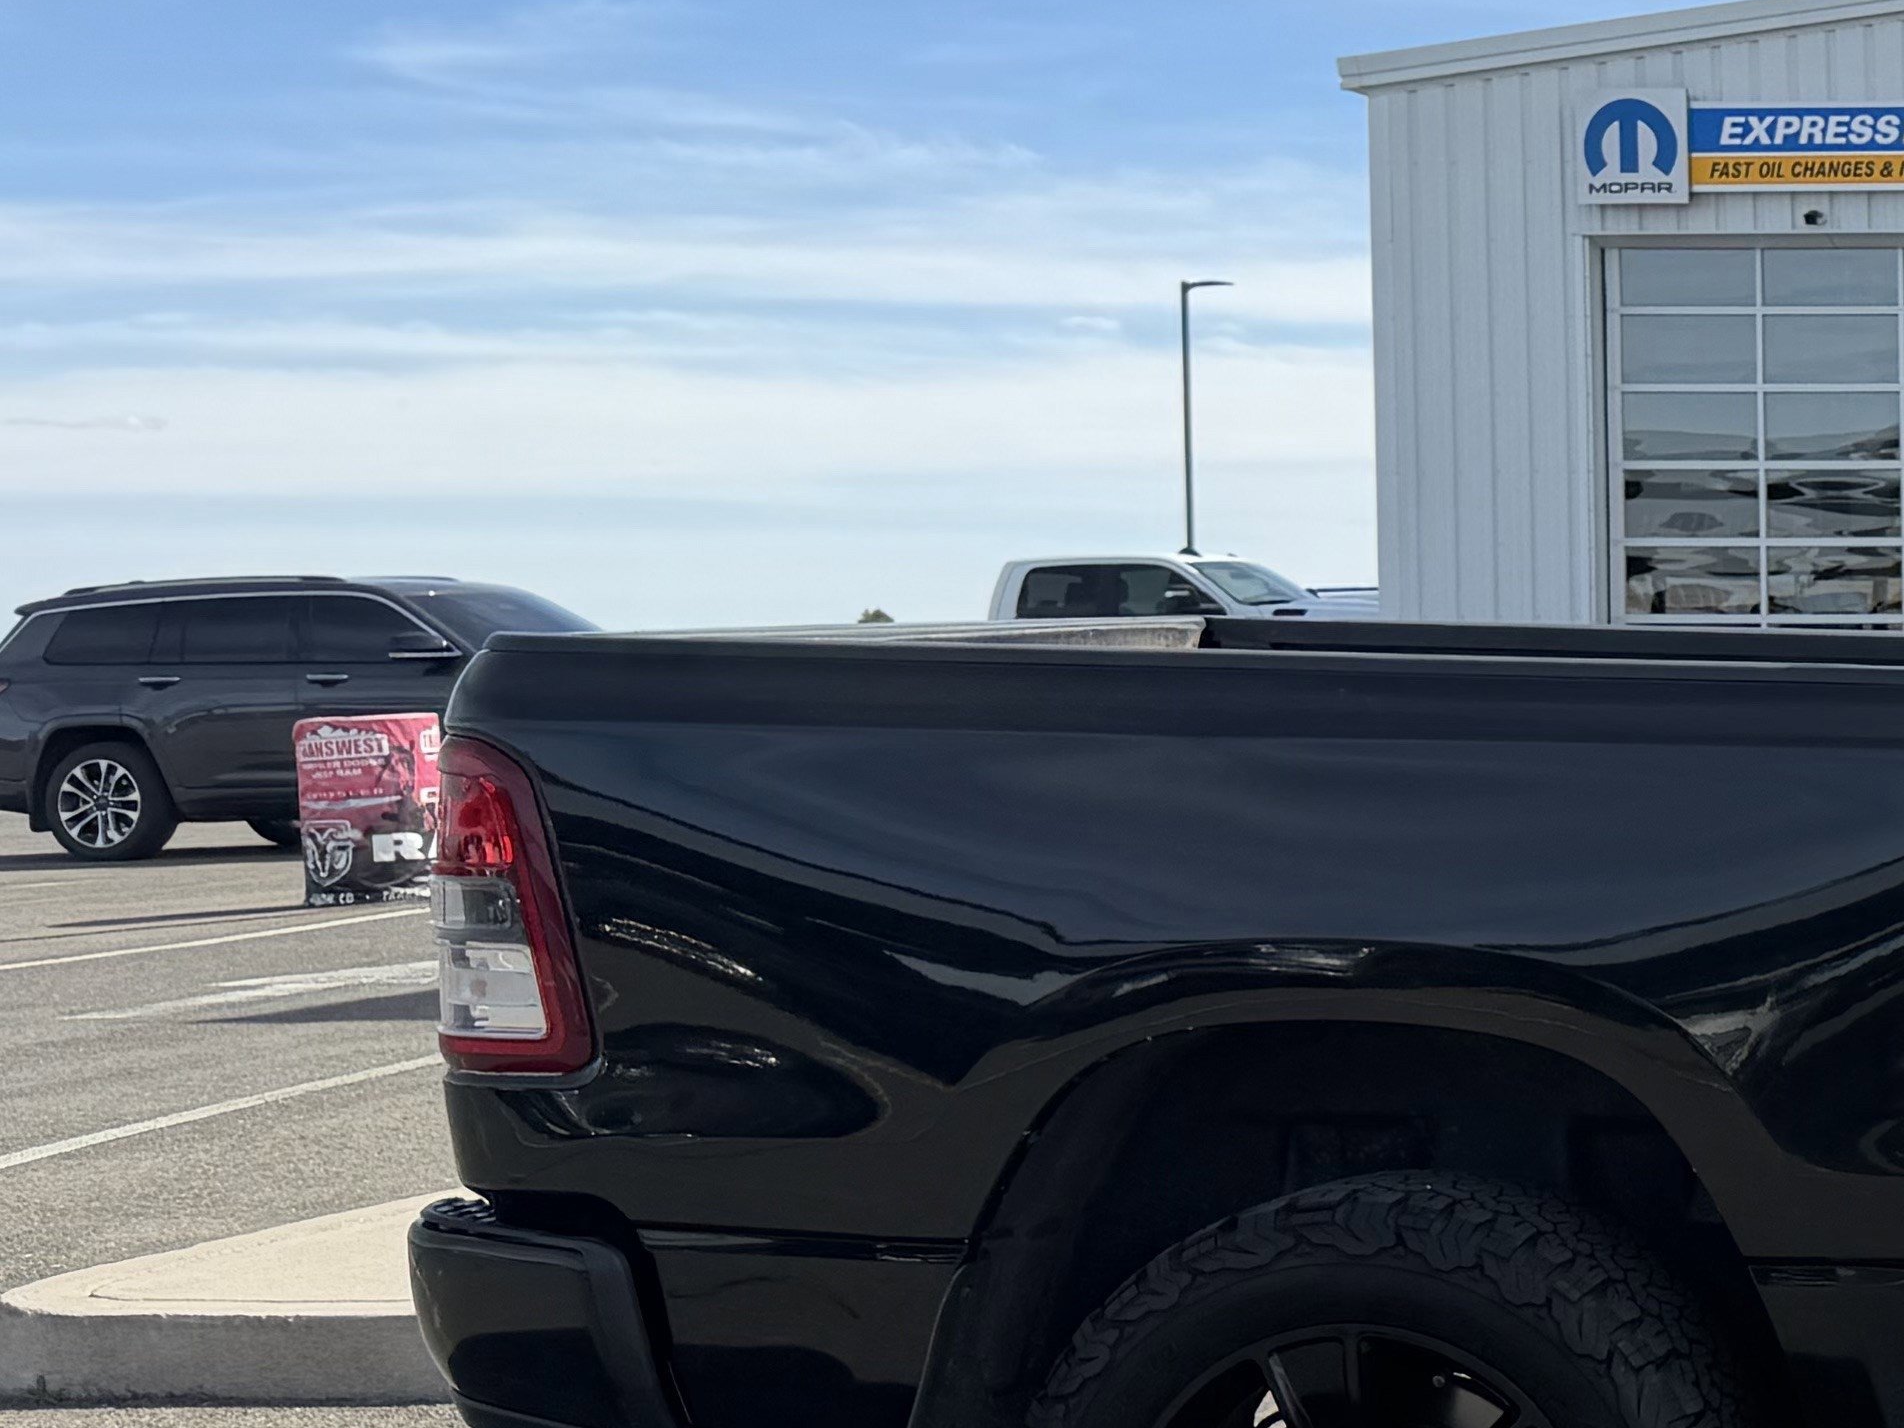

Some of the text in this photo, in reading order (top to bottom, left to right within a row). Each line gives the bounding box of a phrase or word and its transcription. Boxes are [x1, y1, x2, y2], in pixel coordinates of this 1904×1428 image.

[1709, 162, 1752, 179] FAST
[1759, 162, 1785, 179] OIL
[1791, 161, 1876, 179] CHANGES
[1879, 160, 1895, 177] &
[1589, 182, 1673, 194] MOPAR
